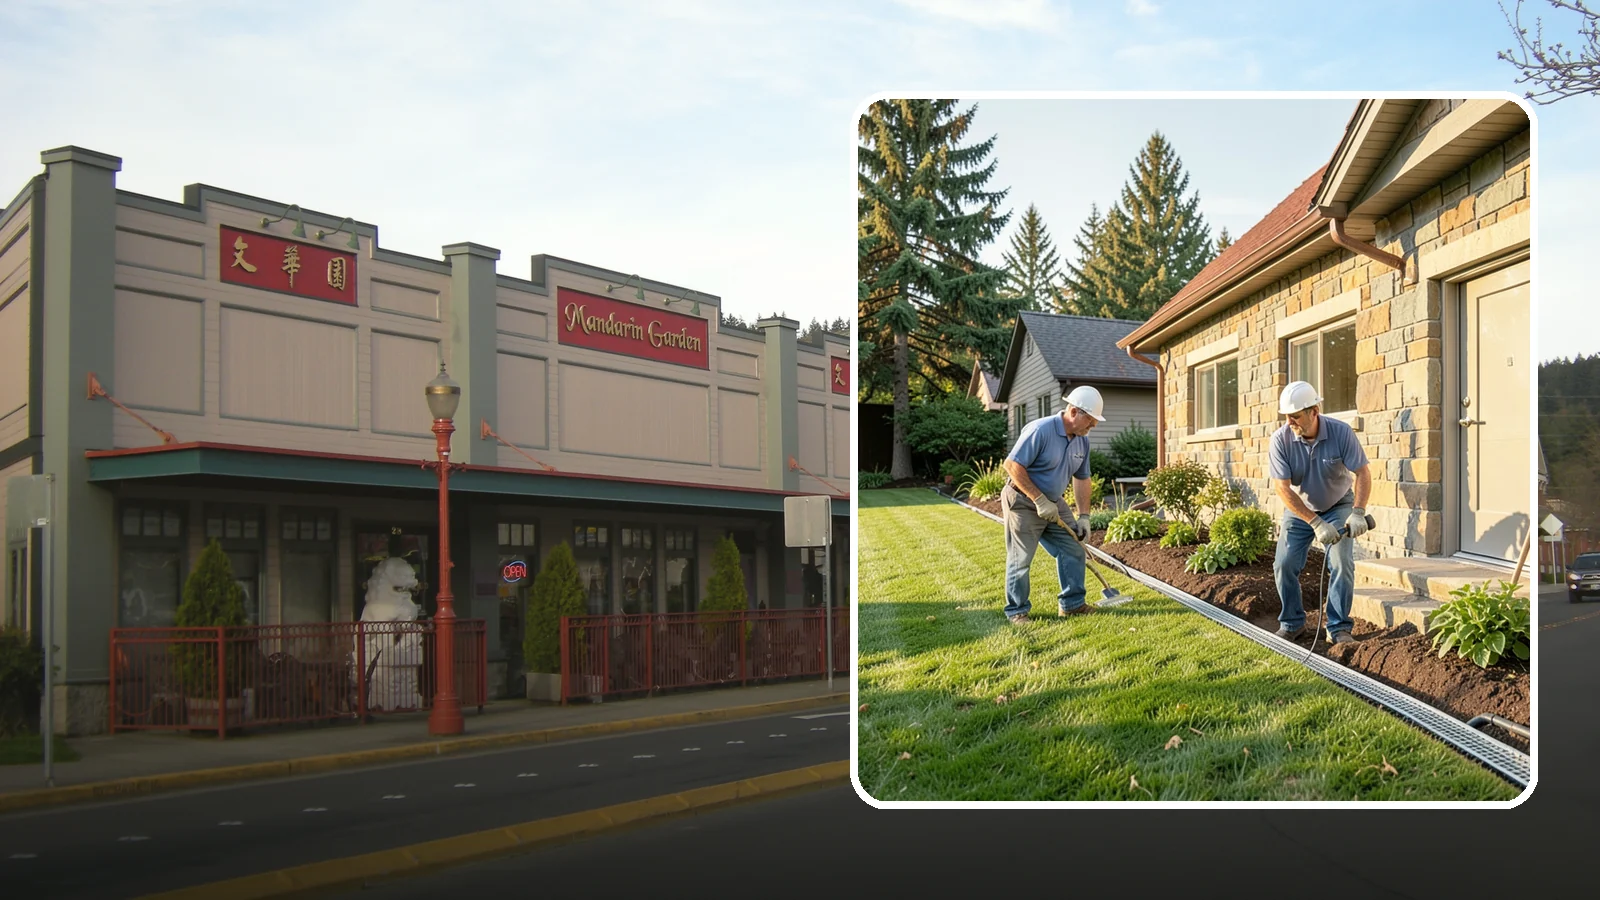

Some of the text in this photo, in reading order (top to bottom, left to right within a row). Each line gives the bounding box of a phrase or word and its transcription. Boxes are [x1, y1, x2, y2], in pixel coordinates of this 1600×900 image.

[231, 235, 346, 291] 文華園
[565, 302, 701, 352] Mandarin Garden
[503, 565, 527, 578] OPEN
